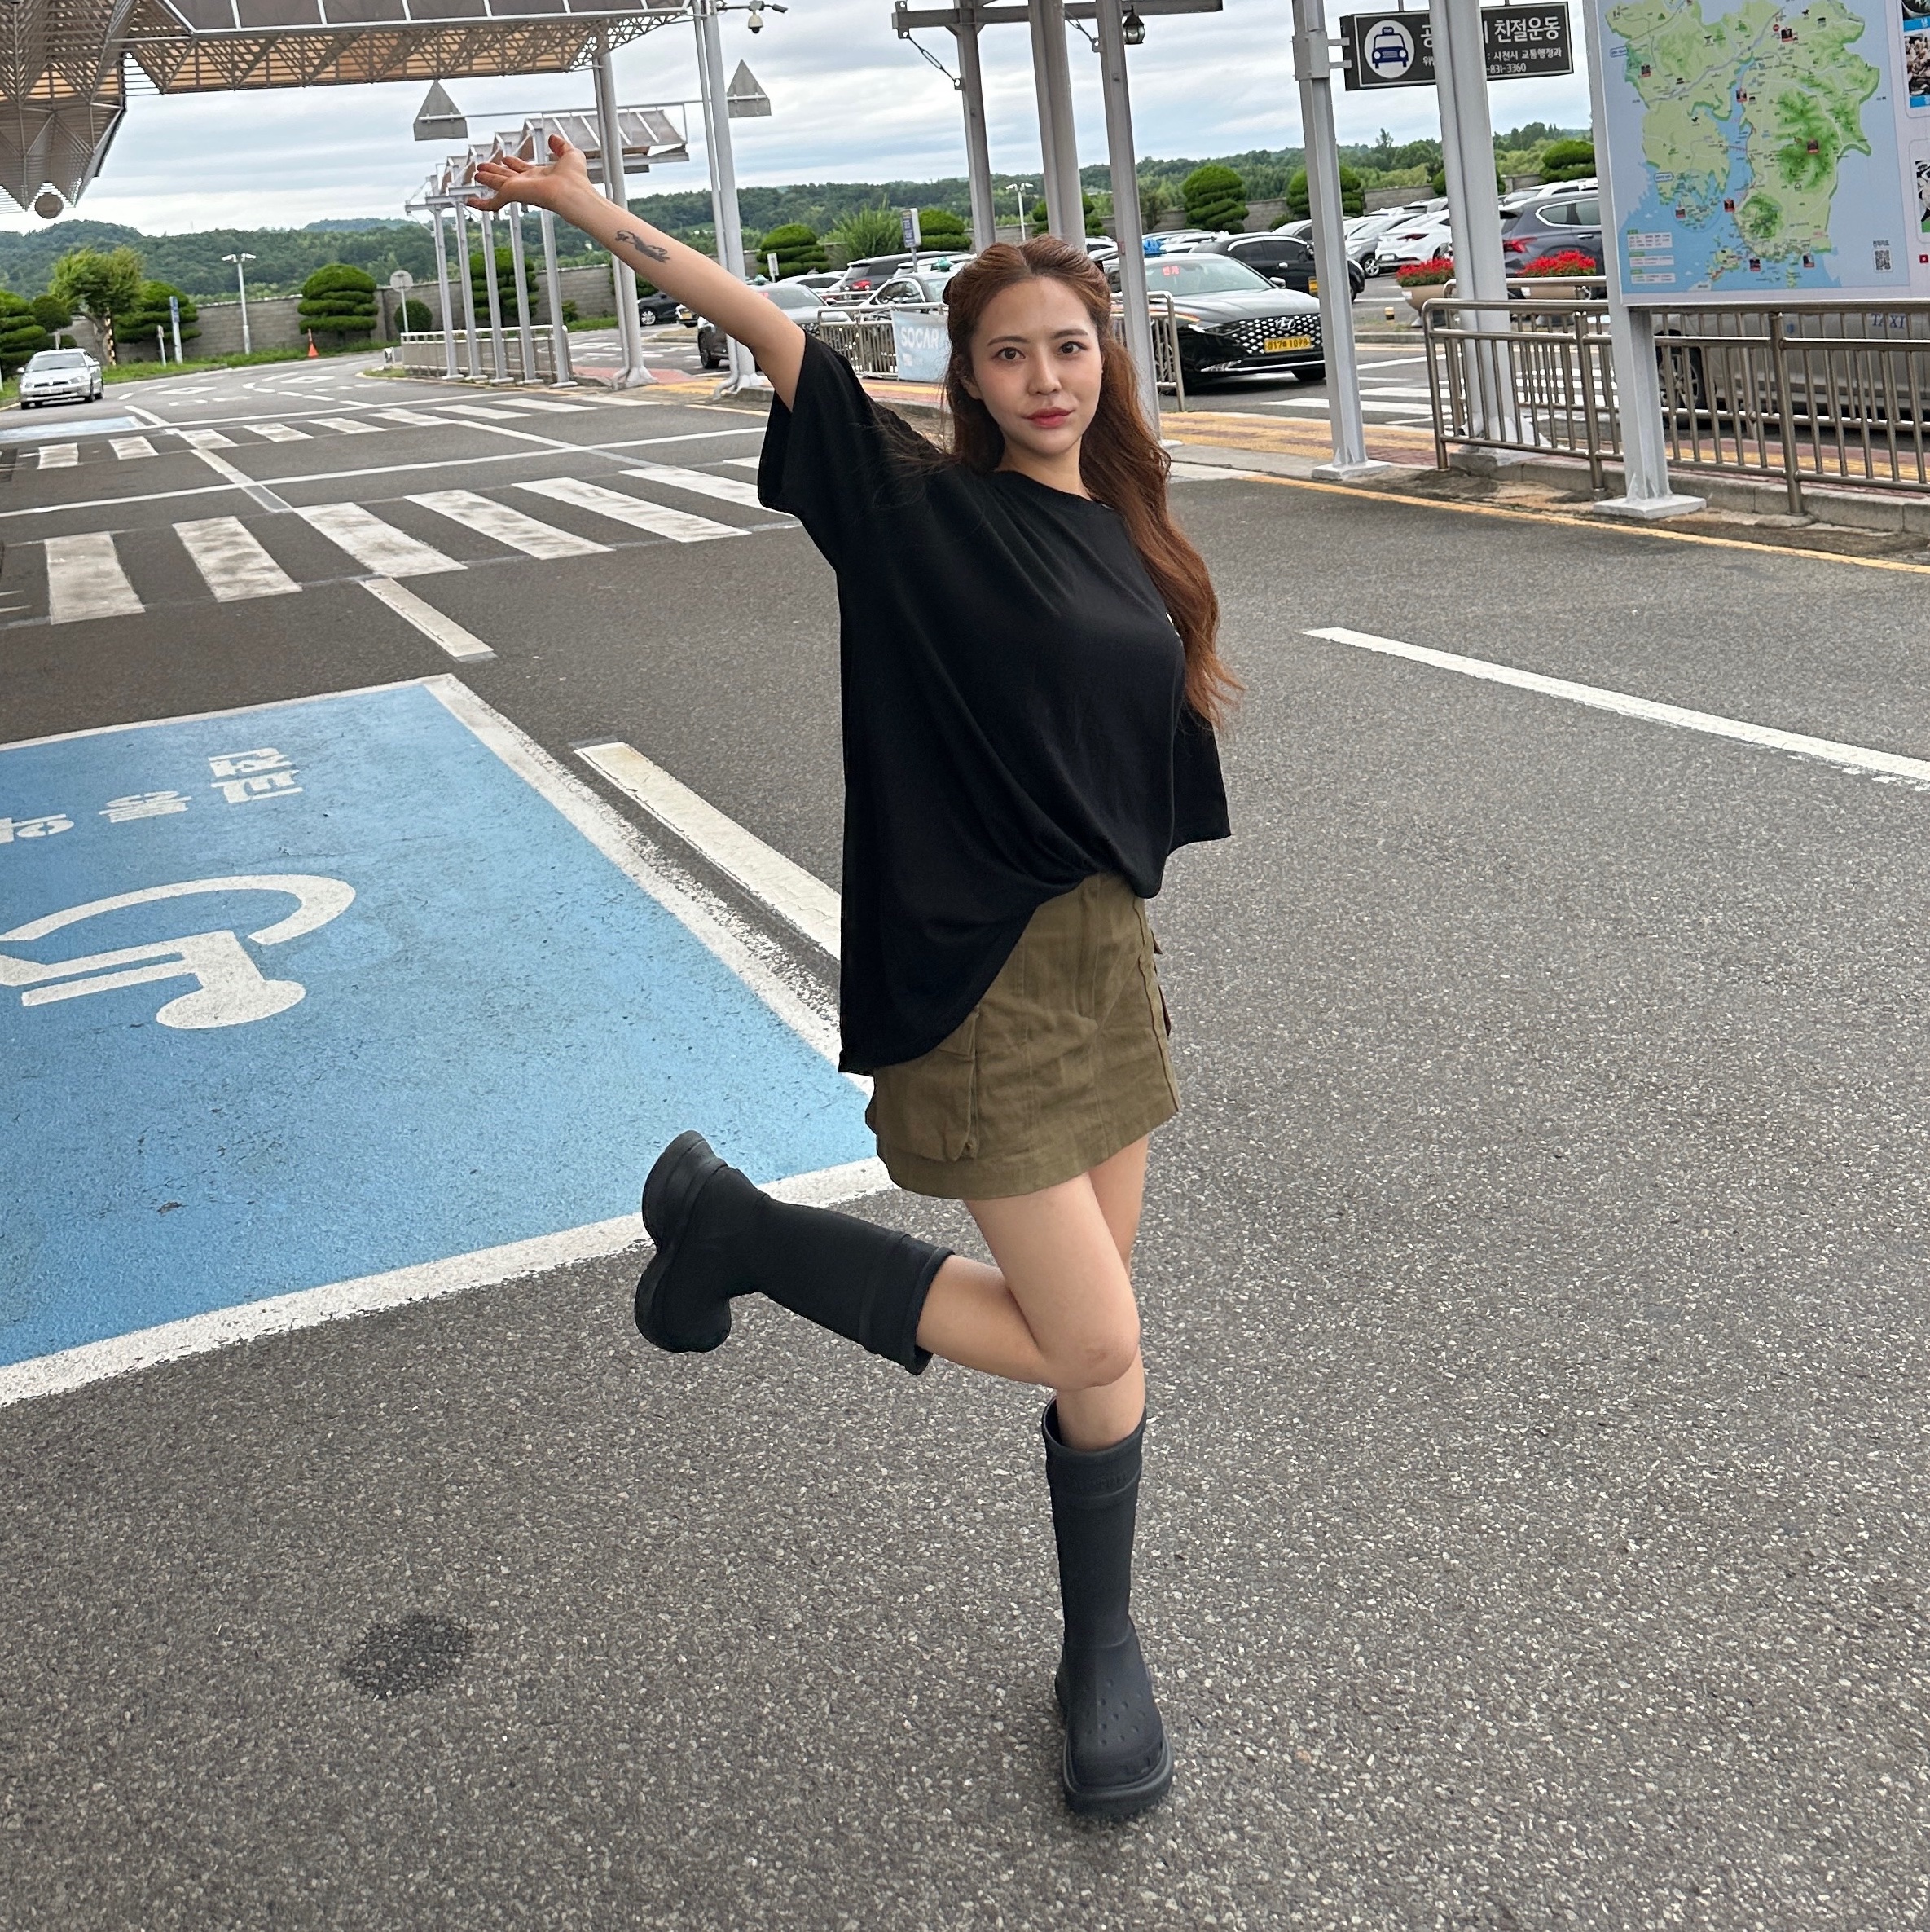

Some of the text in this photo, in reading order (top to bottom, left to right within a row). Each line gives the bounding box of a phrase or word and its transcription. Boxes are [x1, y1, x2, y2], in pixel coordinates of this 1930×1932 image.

[1494, 16, 1561, 43] 친절운동
[1493, 51, 1519, 62] 사천시
[1486, 63, 1527, 74] -831-3360
[1871, 313, 1907, 329] TAXI
[900, 326, 939, 349] SOCAR
